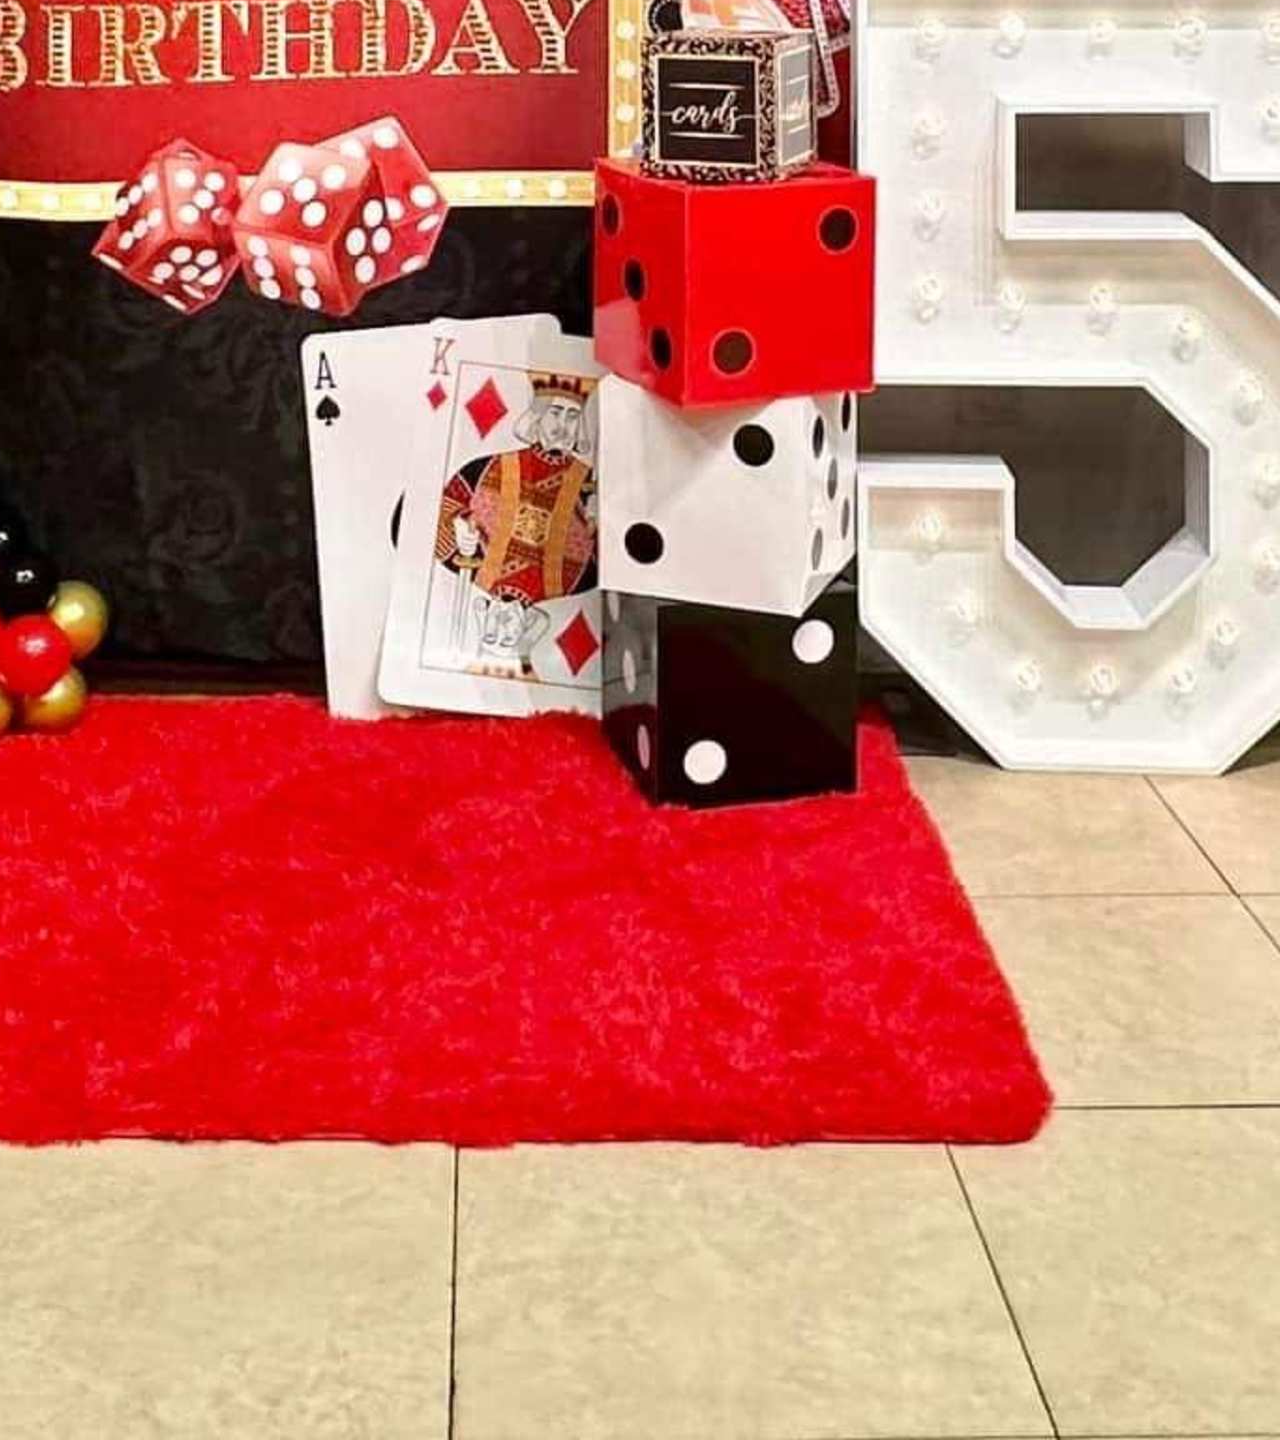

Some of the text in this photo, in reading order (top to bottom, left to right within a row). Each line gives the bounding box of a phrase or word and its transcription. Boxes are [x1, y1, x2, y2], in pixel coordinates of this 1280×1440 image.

[666, 91, 742, 133] cards
[314, 350, 337, 389] A
[429, 337, 455, 376] K
